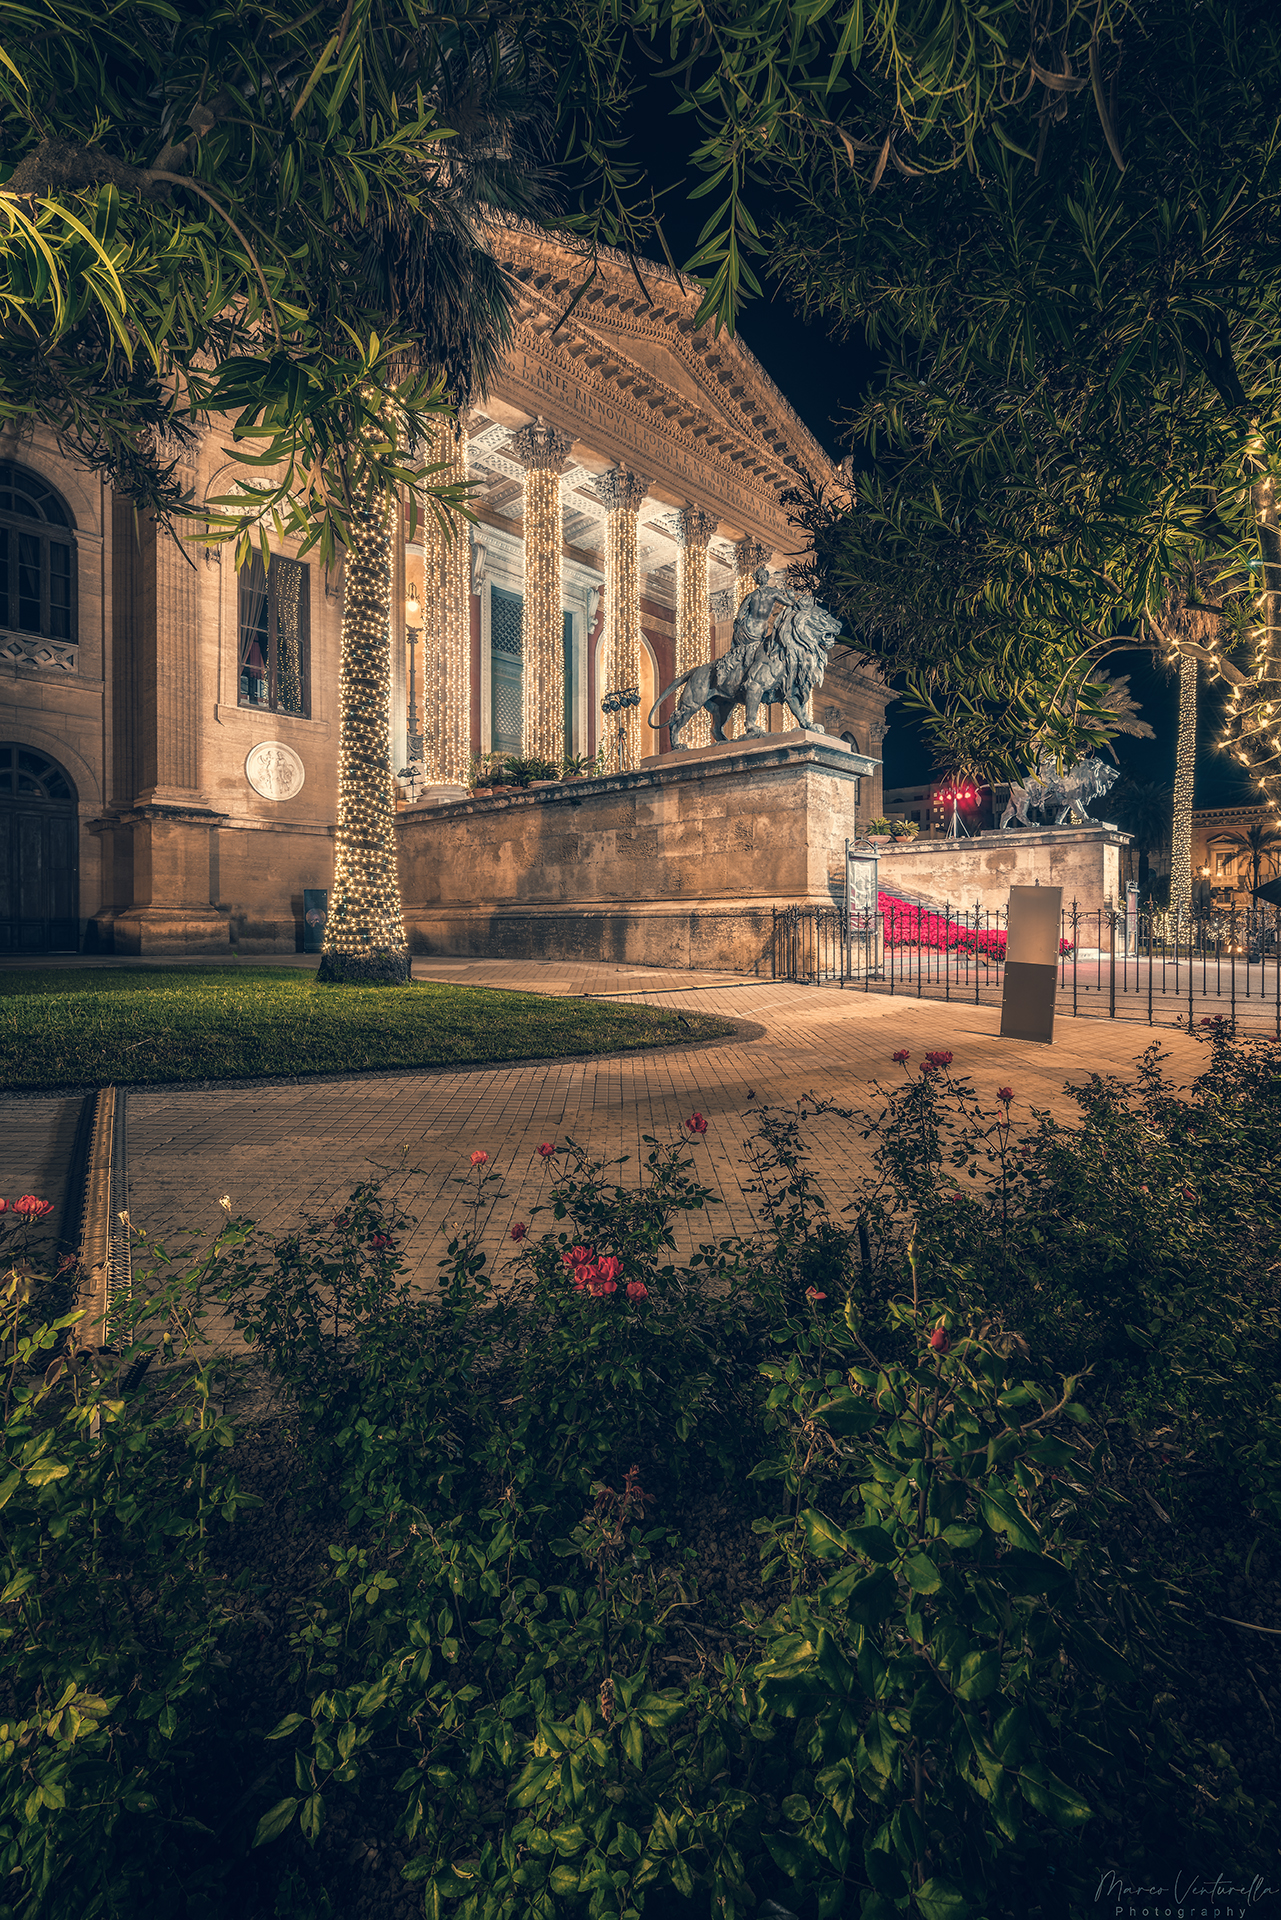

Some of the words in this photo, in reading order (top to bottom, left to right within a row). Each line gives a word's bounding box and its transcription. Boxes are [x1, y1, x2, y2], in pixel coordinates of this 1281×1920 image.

[523, 369, 552, 394] DELLE
[560, 392, 592, 418] SCENE
[599, 415, 608, 427] IL
[614, 424, 649, 451] DILETTO
[655, 450, 670, 464] OVE
[676, 462, 693, 477] NON
[699, 475, 715, 490] MIRI
[576, 388, 628, 430] RINNOVA
[644, 430, 678, 459] POPOLI
[683, 455, 689, 465] E
[694, 461, 705, 476] NE
[711, 472, 741, 497] RIVELA
[746, 493, 755, 506] LA
[759, 500, 777, 518] VITA
